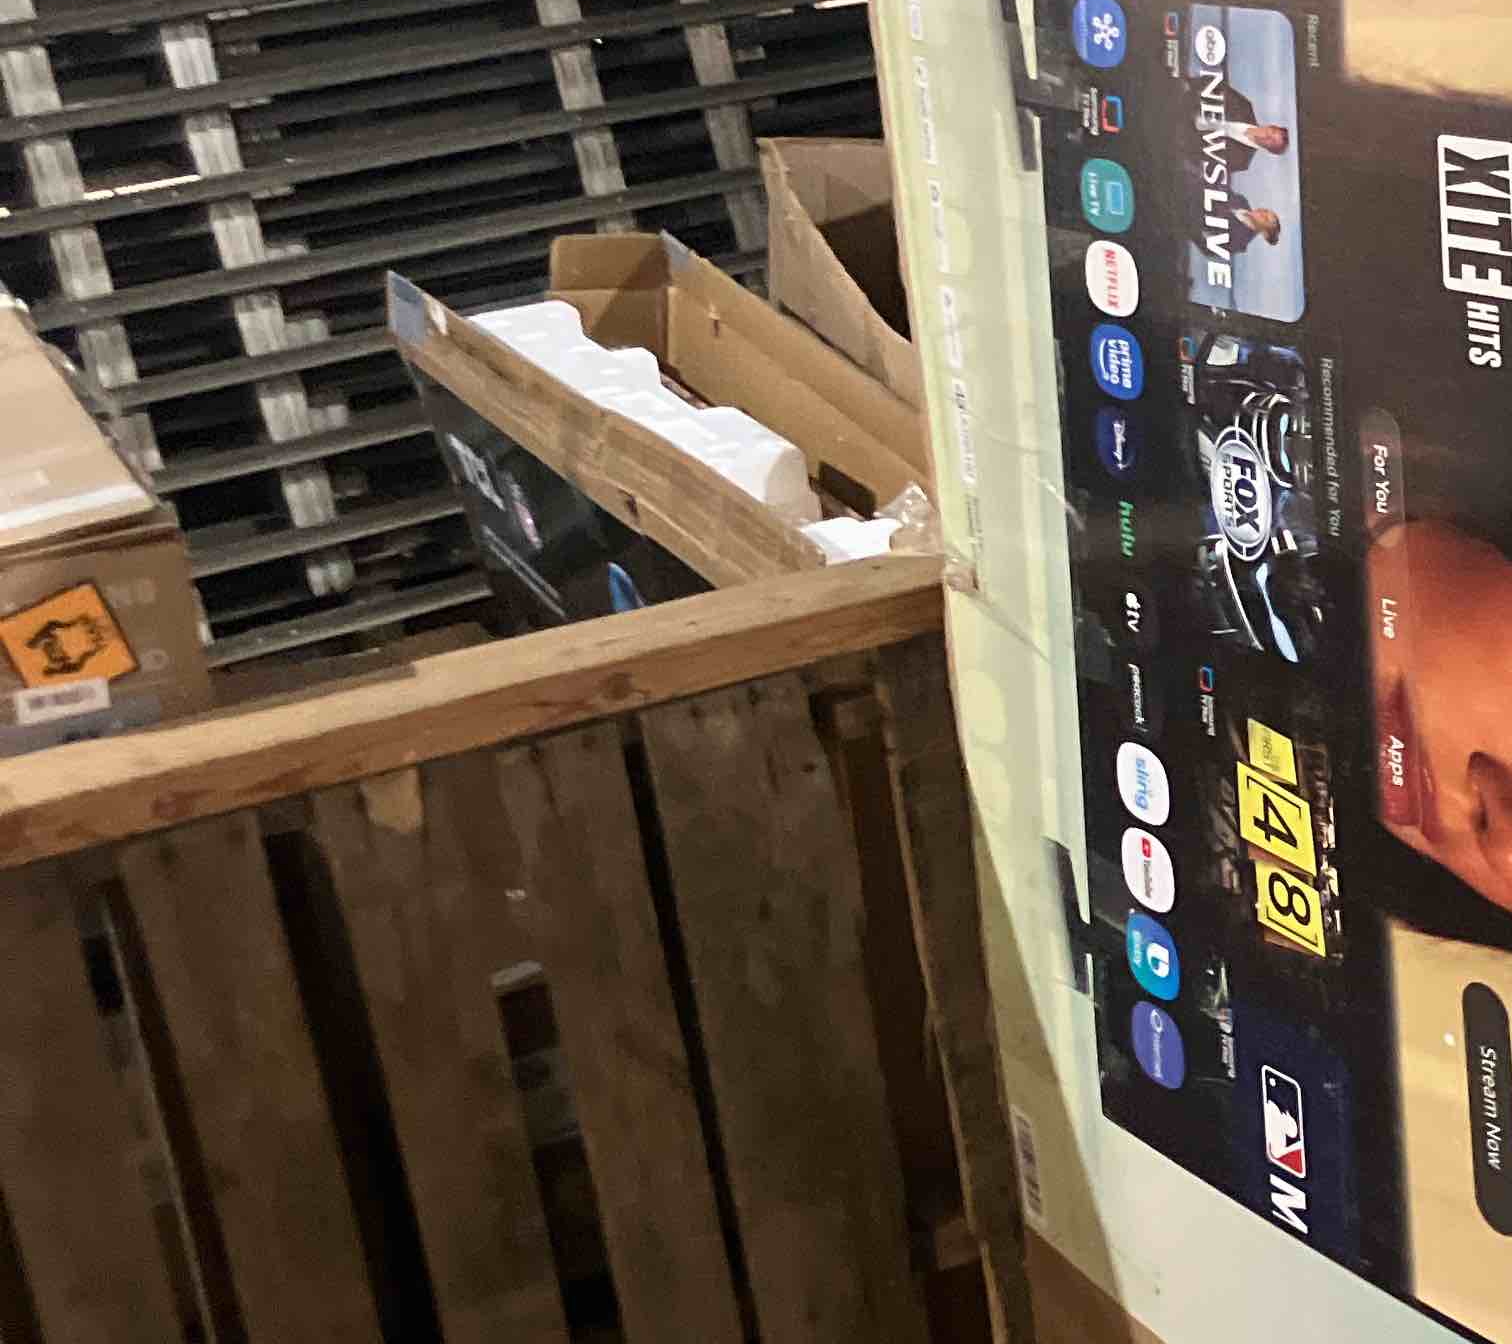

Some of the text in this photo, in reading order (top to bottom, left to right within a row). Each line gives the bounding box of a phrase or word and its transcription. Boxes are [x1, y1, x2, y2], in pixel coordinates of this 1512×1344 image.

[1306, 14, 1320, 67] Recent
[1200, 70, 1228, 186] NEWS
[1089, 200, 1100, 217] TV
[1203, 188, 1233, 289] LIVE
[1103, 249, 1120, 311] NETFLIX
[1107, 338, 1121, 385] video
[1117, 339, 1133, 389] prime
[1466, 300, 1503, 369] HITS
[1319, 357, 1341, 537] Recommended for You
[1221, 452, 1234, 529] SPORTS
[1232, 456, 1260, 534] FOX
[1373, 443, 1392, 514] For You
[1117, 500, 1136, 558] hulu
[1381, 596, 1398, 638] Live
[1134, 757, 1151, 811] sling
[1385, 735, 1406, 787] Apps
[1476, 1046, 1504, 1171] Stream Now
